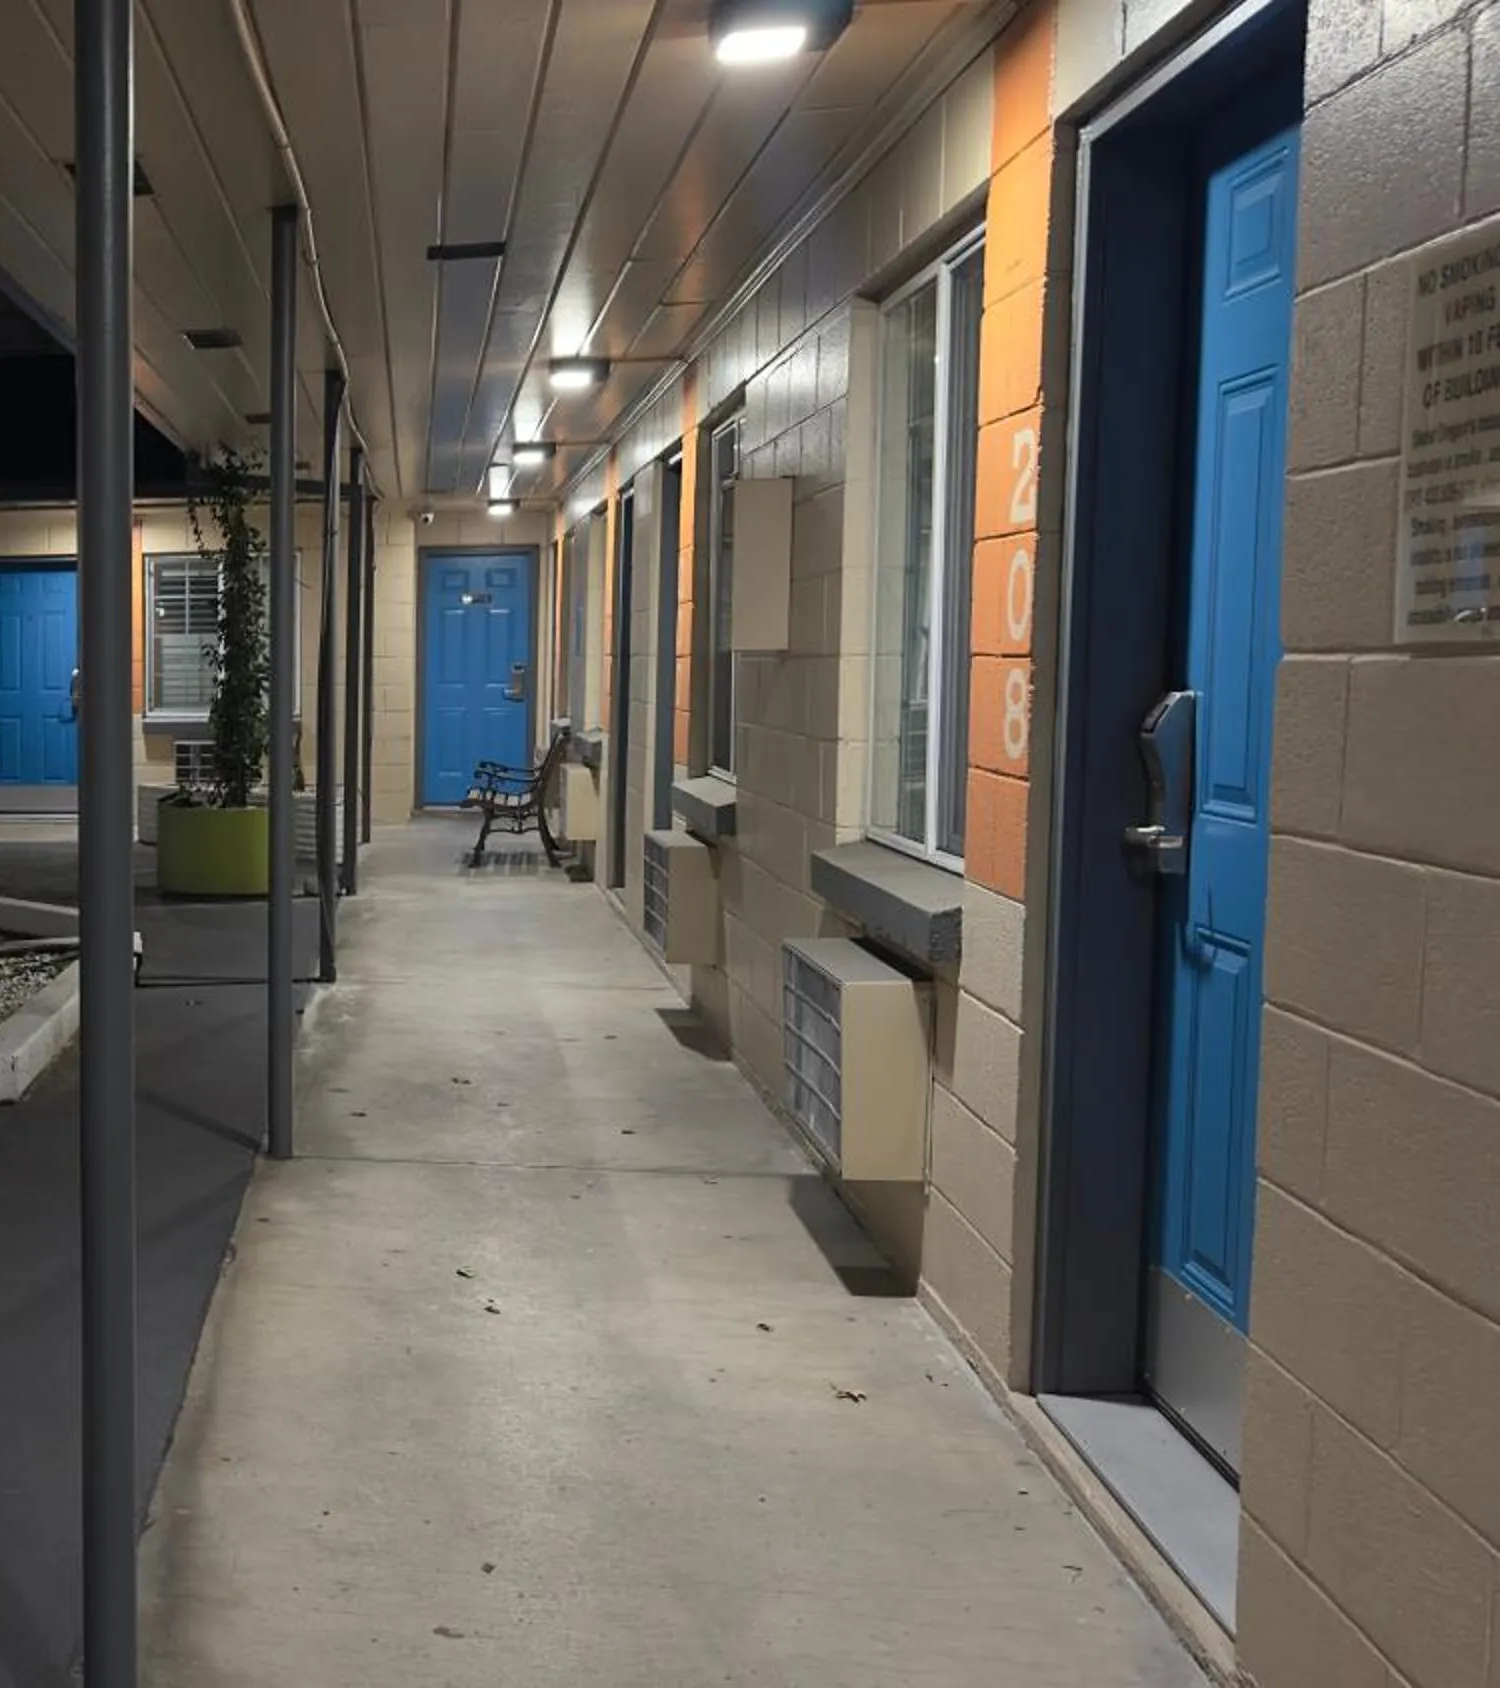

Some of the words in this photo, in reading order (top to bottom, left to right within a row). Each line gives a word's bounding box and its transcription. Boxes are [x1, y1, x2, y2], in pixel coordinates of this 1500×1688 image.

[1418, 269, 1438, 297] NO
[1422, 381, 1441, 411] OF
[1444, 364, 1500, 402] BUILDIN
[1004, 428, 1039, 759] 208
